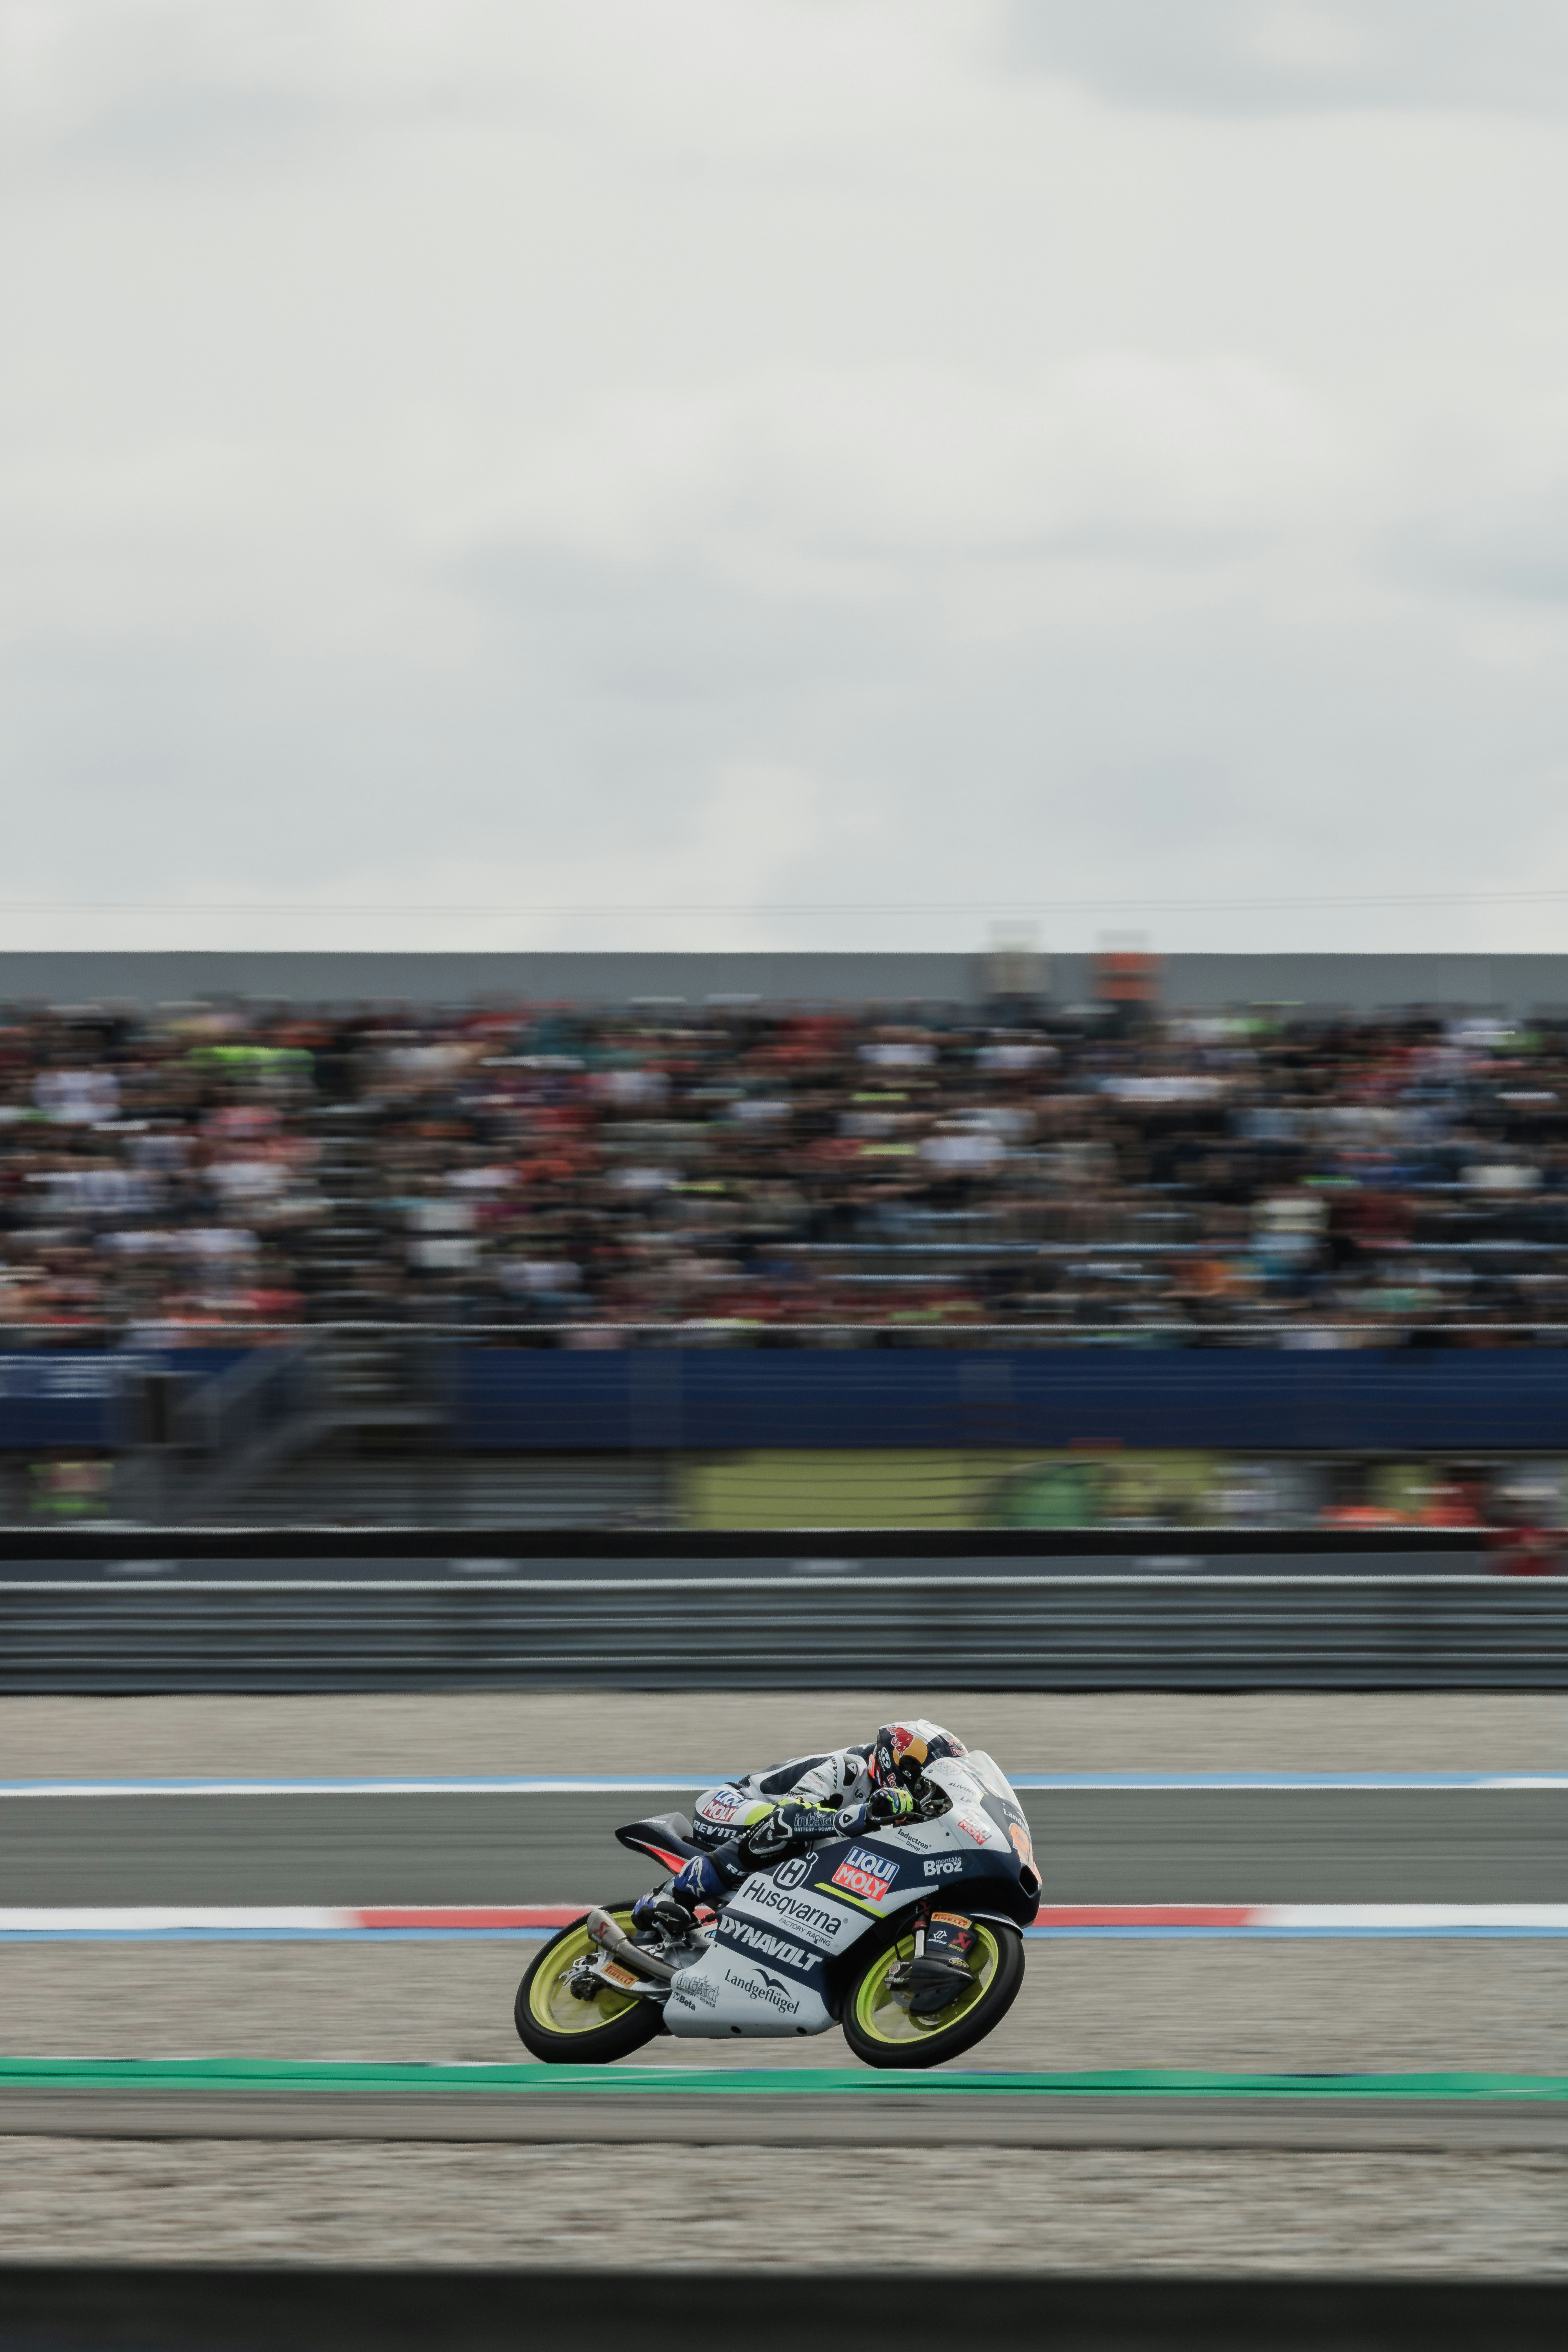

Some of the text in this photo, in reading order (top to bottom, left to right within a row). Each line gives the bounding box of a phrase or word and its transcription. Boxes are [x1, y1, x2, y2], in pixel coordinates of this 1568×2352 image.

[704, 1801, 738, 1822] MOLY
[693, 1819, 737, 1838] REV'IT!
[906, 1841, 920, 1852] Group
[846, 1849, 896, 1881] LIQUI
[935, 1856, 962, 1865] montáže
[836, 1866, 887, 1898] MOLY
[933, 1914, 968, 1927] PIRELLI
[718, 1915, 823, 1971] DYNAVOLT
[779, 1918, 831, 1947] FACTORY RACING
[604, 1964, 634, 1985] PIRELLI
[700, 1996, 716, 2008] POWER
[725, 1969, 800, 2014] Landgeflügel
[679, 1994, 696, 2011] Beta
